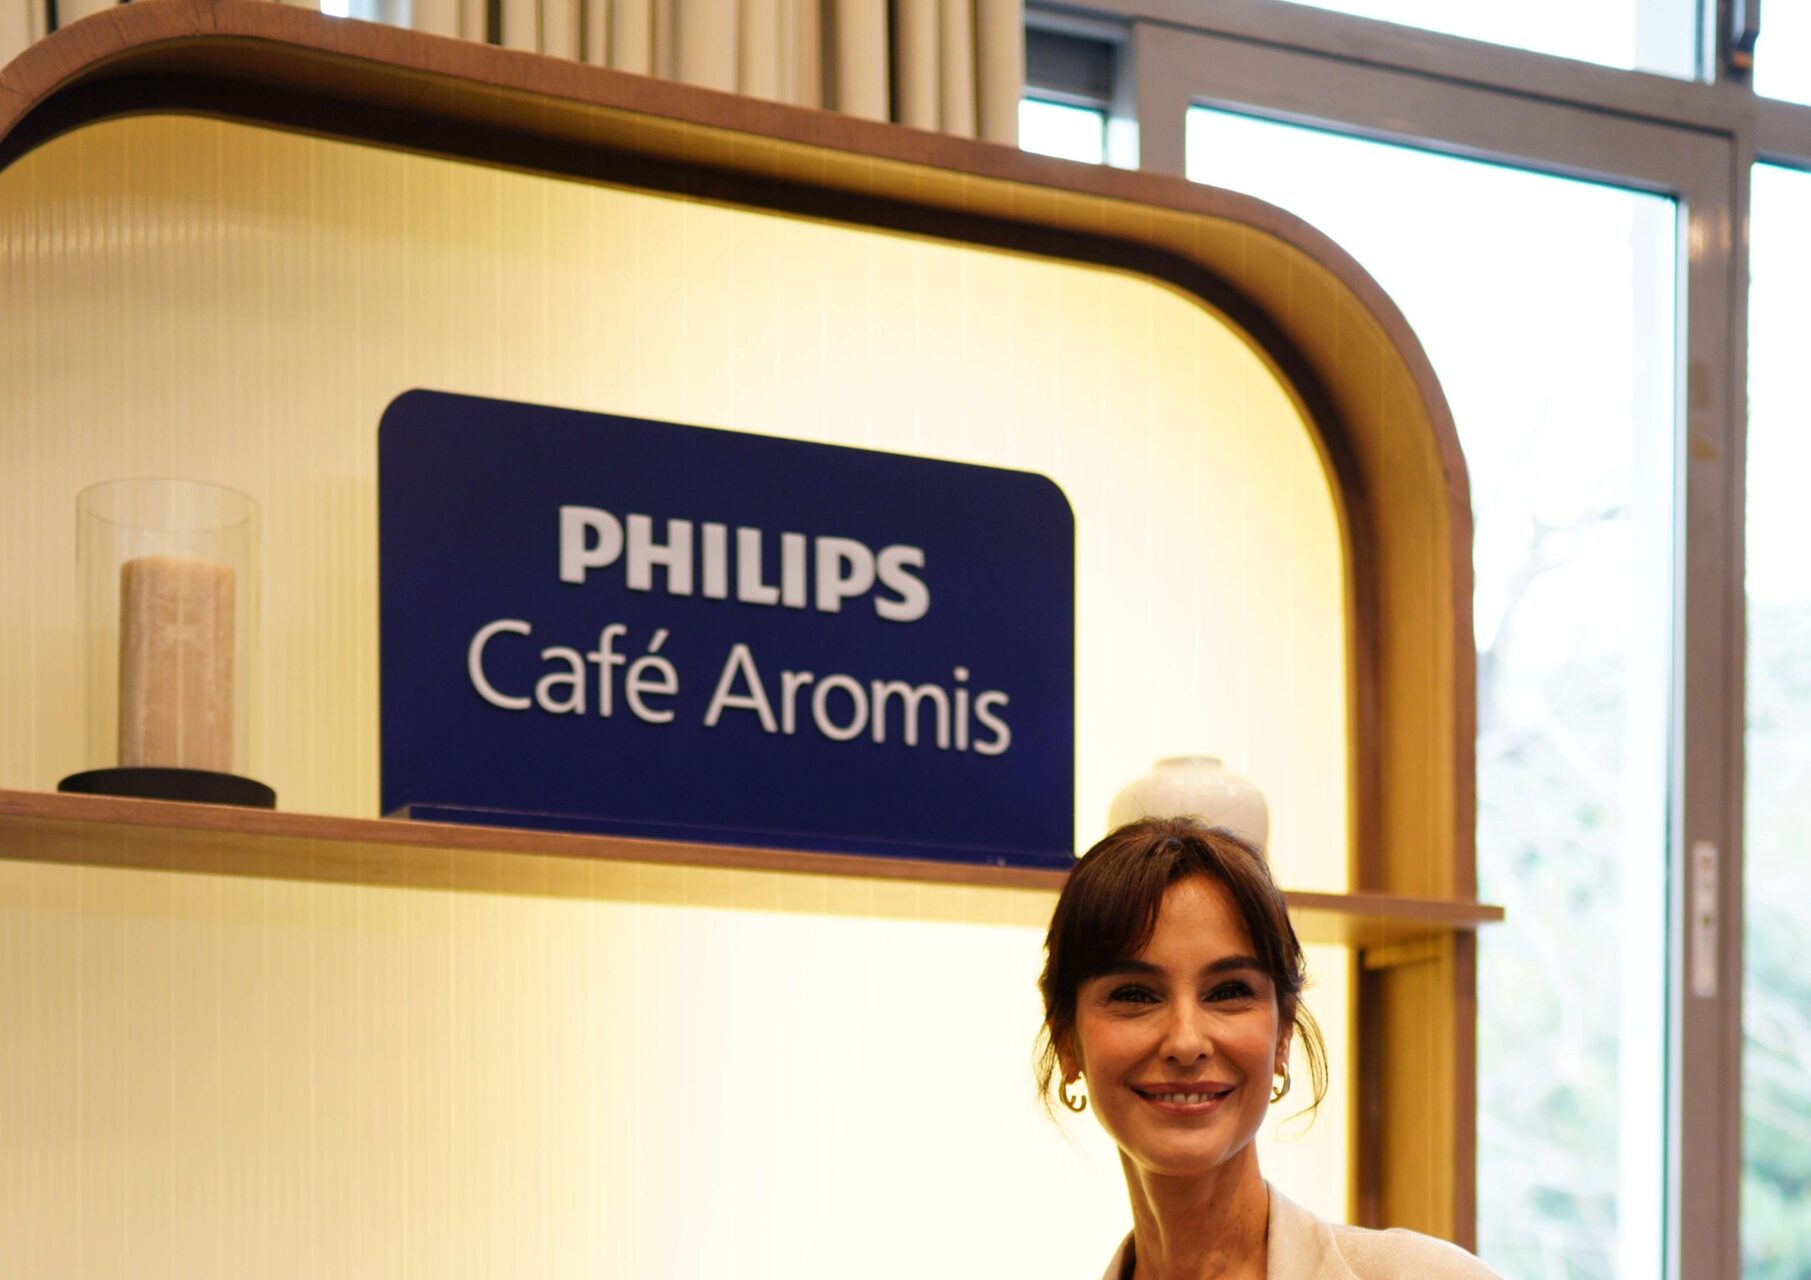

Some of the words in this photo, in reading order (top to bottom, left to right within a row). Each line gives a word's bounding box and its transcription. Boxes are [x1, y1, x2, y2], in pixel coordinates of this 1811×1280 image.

[558, 504, 931, 622] PHILIPS
[467, 618, 679, 725] Café
[703, 643, 1013, 757] Aromis
